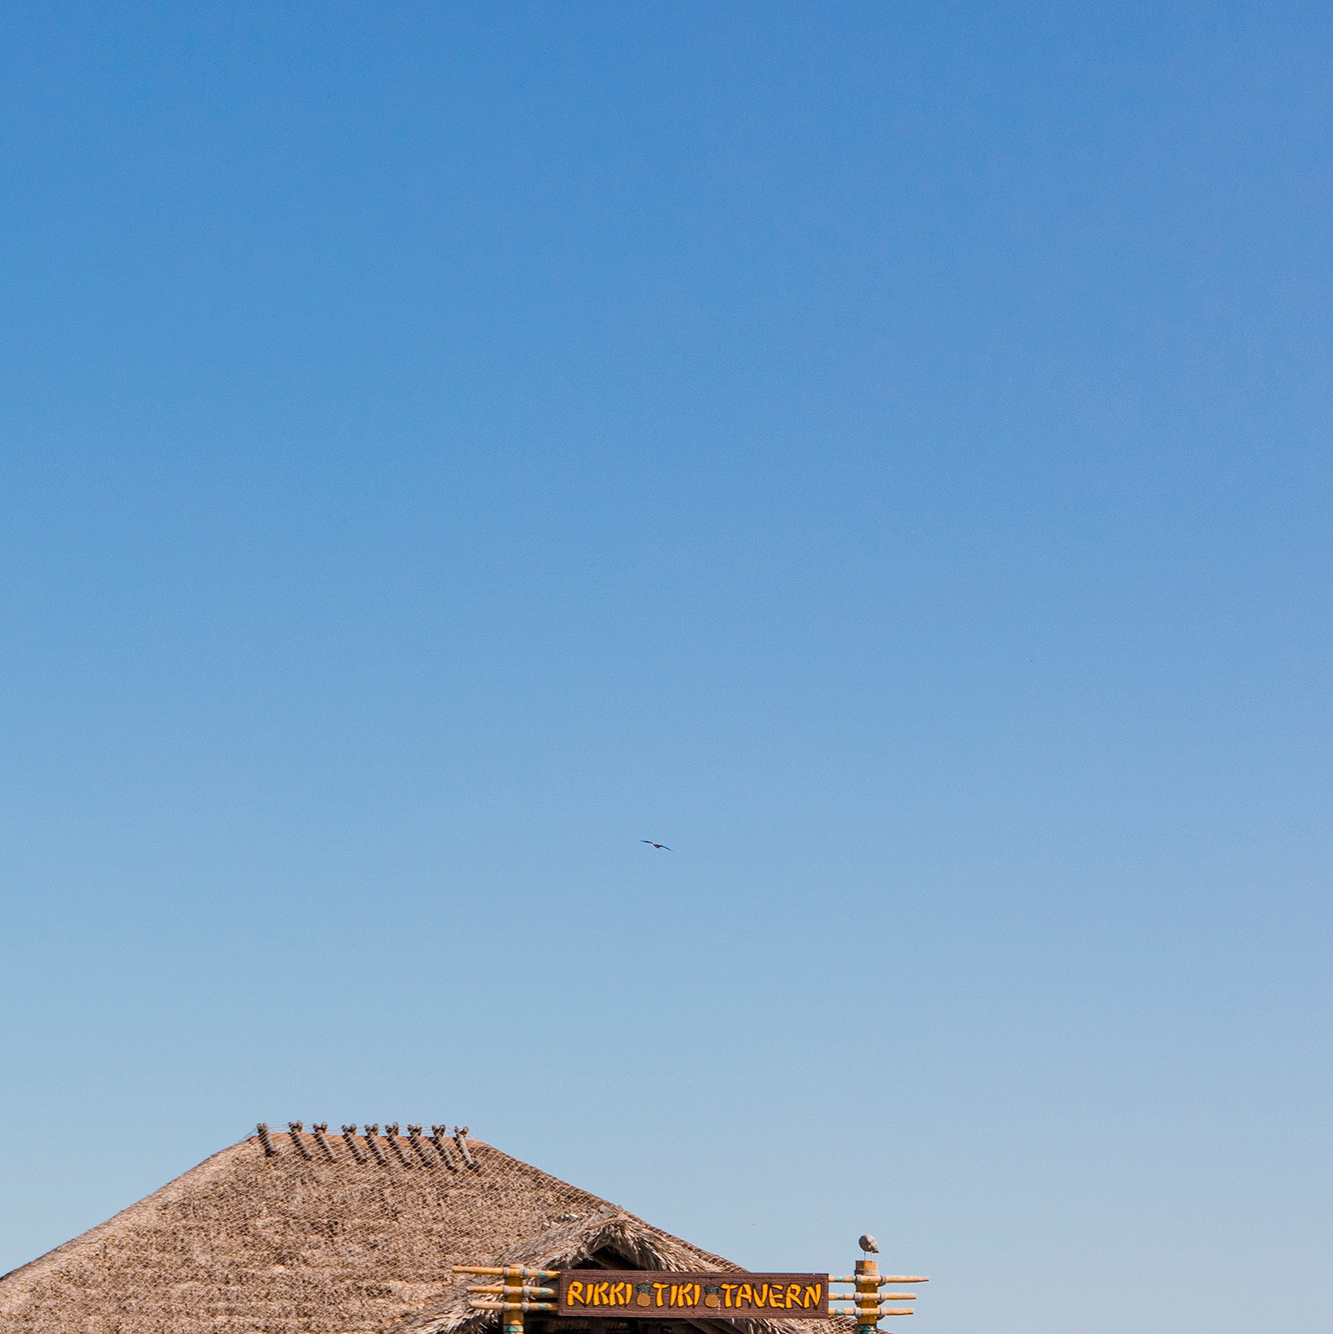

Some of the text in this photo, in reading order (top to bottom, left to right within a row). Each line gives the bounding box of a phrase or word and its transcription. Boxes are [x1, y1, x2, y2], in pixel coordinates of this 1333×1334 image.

[567, 1281, 822, 1308] RIKKI TIKI TAVERN
